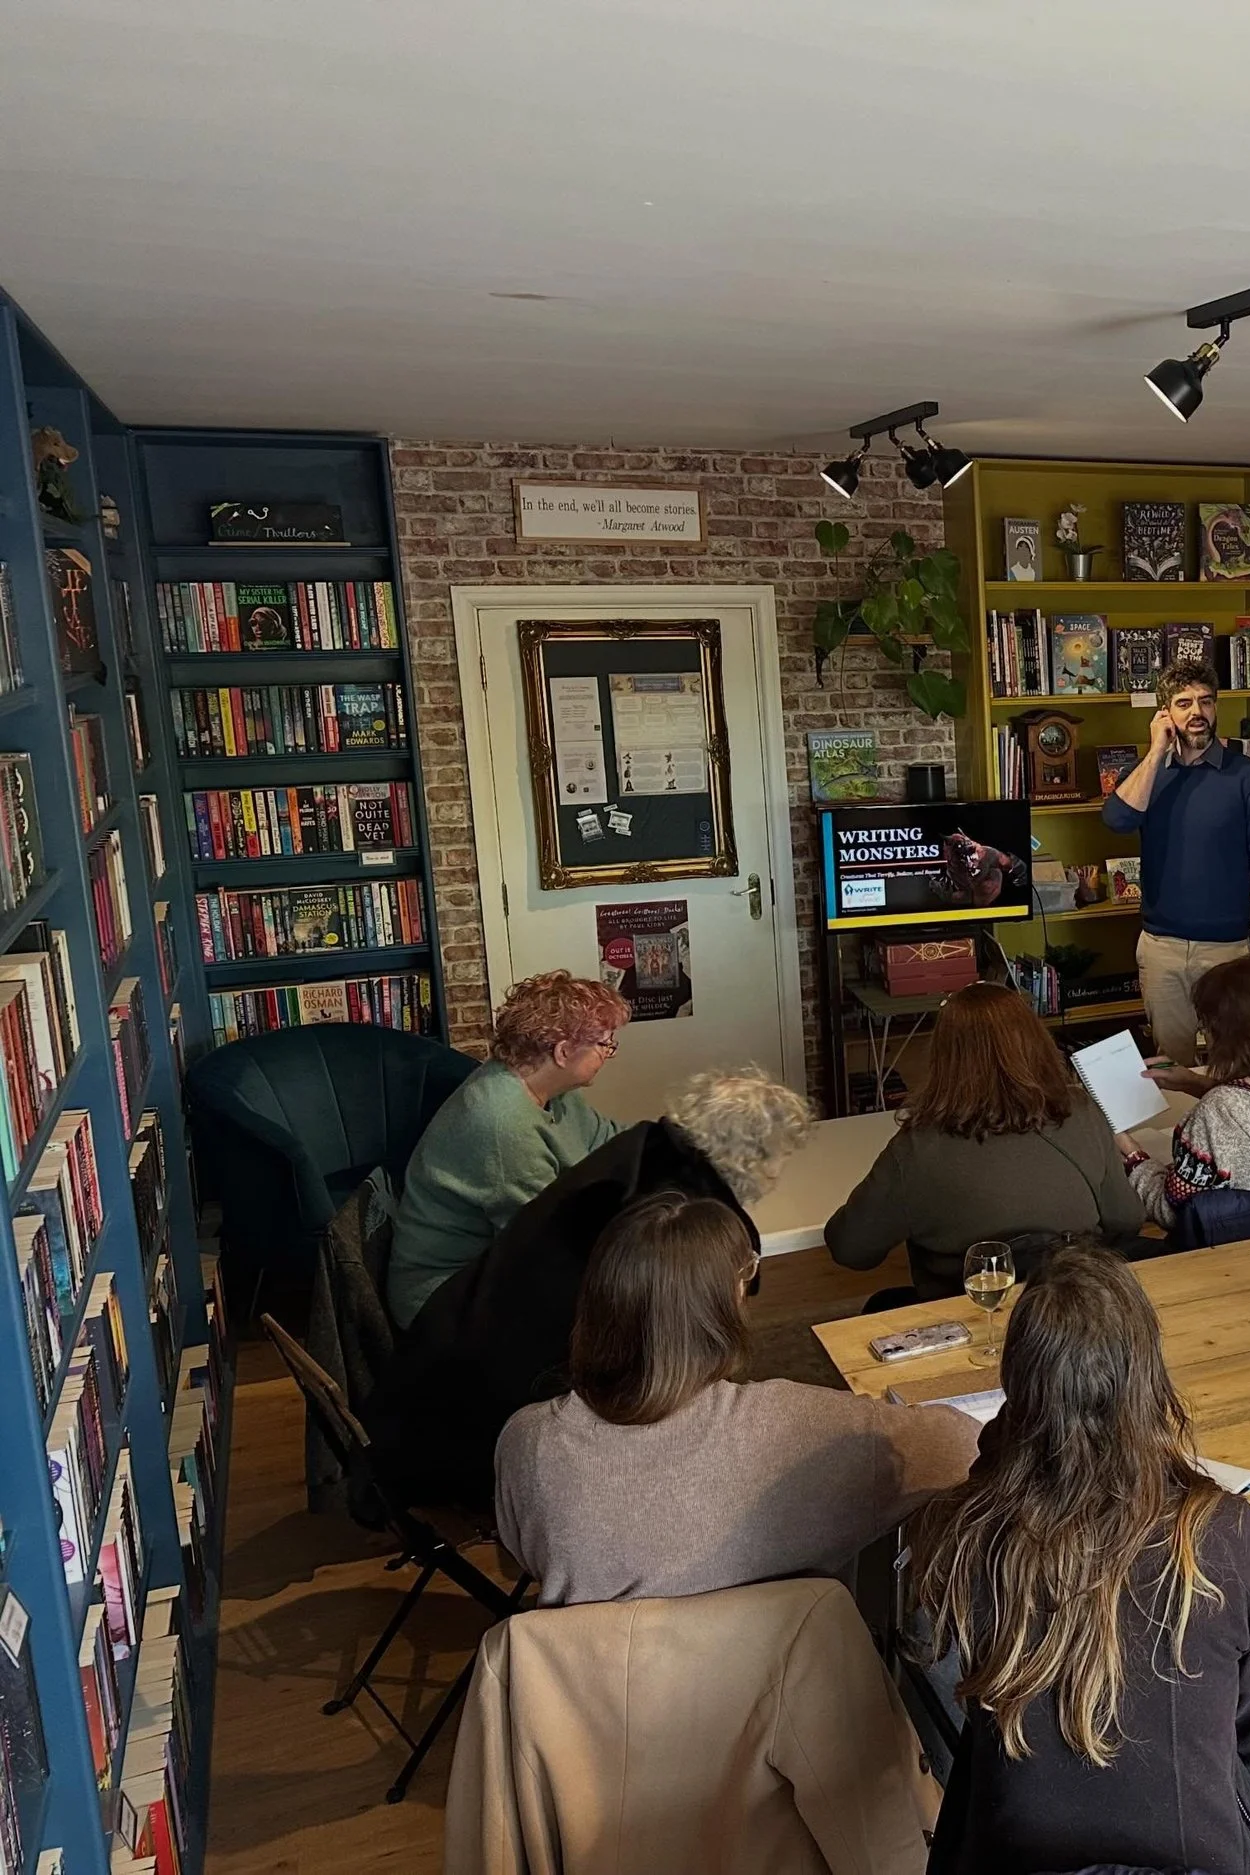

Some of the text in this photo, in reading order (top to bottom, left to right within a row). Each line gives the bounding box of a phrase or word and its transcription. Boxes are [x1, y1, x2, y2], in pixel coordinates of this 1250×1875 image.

[522, 498, 533, 510] In
[538, 498, 554, 511] the
[559, 500, 578, 513] end,
[583, 500, 605, 512] we'll
[609, 501, 621, 512] all
[626, 501, 659, 513] become
[651, 521, 685, 532] Atwood
[1070, 623, 1090, 631] SPACE
[343, 701, 379, 714] TRAP
[346, 737, 384, 745] EDWARDS
[812, 739, 873, 749] DINOSAUR
[814, 749, 845, 758] ATLAS
[360, 801, 383, 809] NOT
[355, 810, 389, 818] QUITE
[359, 823, 389, 831] DEAD
[365, 832, 384, 840] YET
[838, 828, 923, 843] WRITING
[840, 845, 939, 862] MONSTERS
[293, 903, 337, 912] DAMASCUS
[196, 898, 214, 957] STEPHEN KING
[304, 999, 342, 1009] OSMAN
